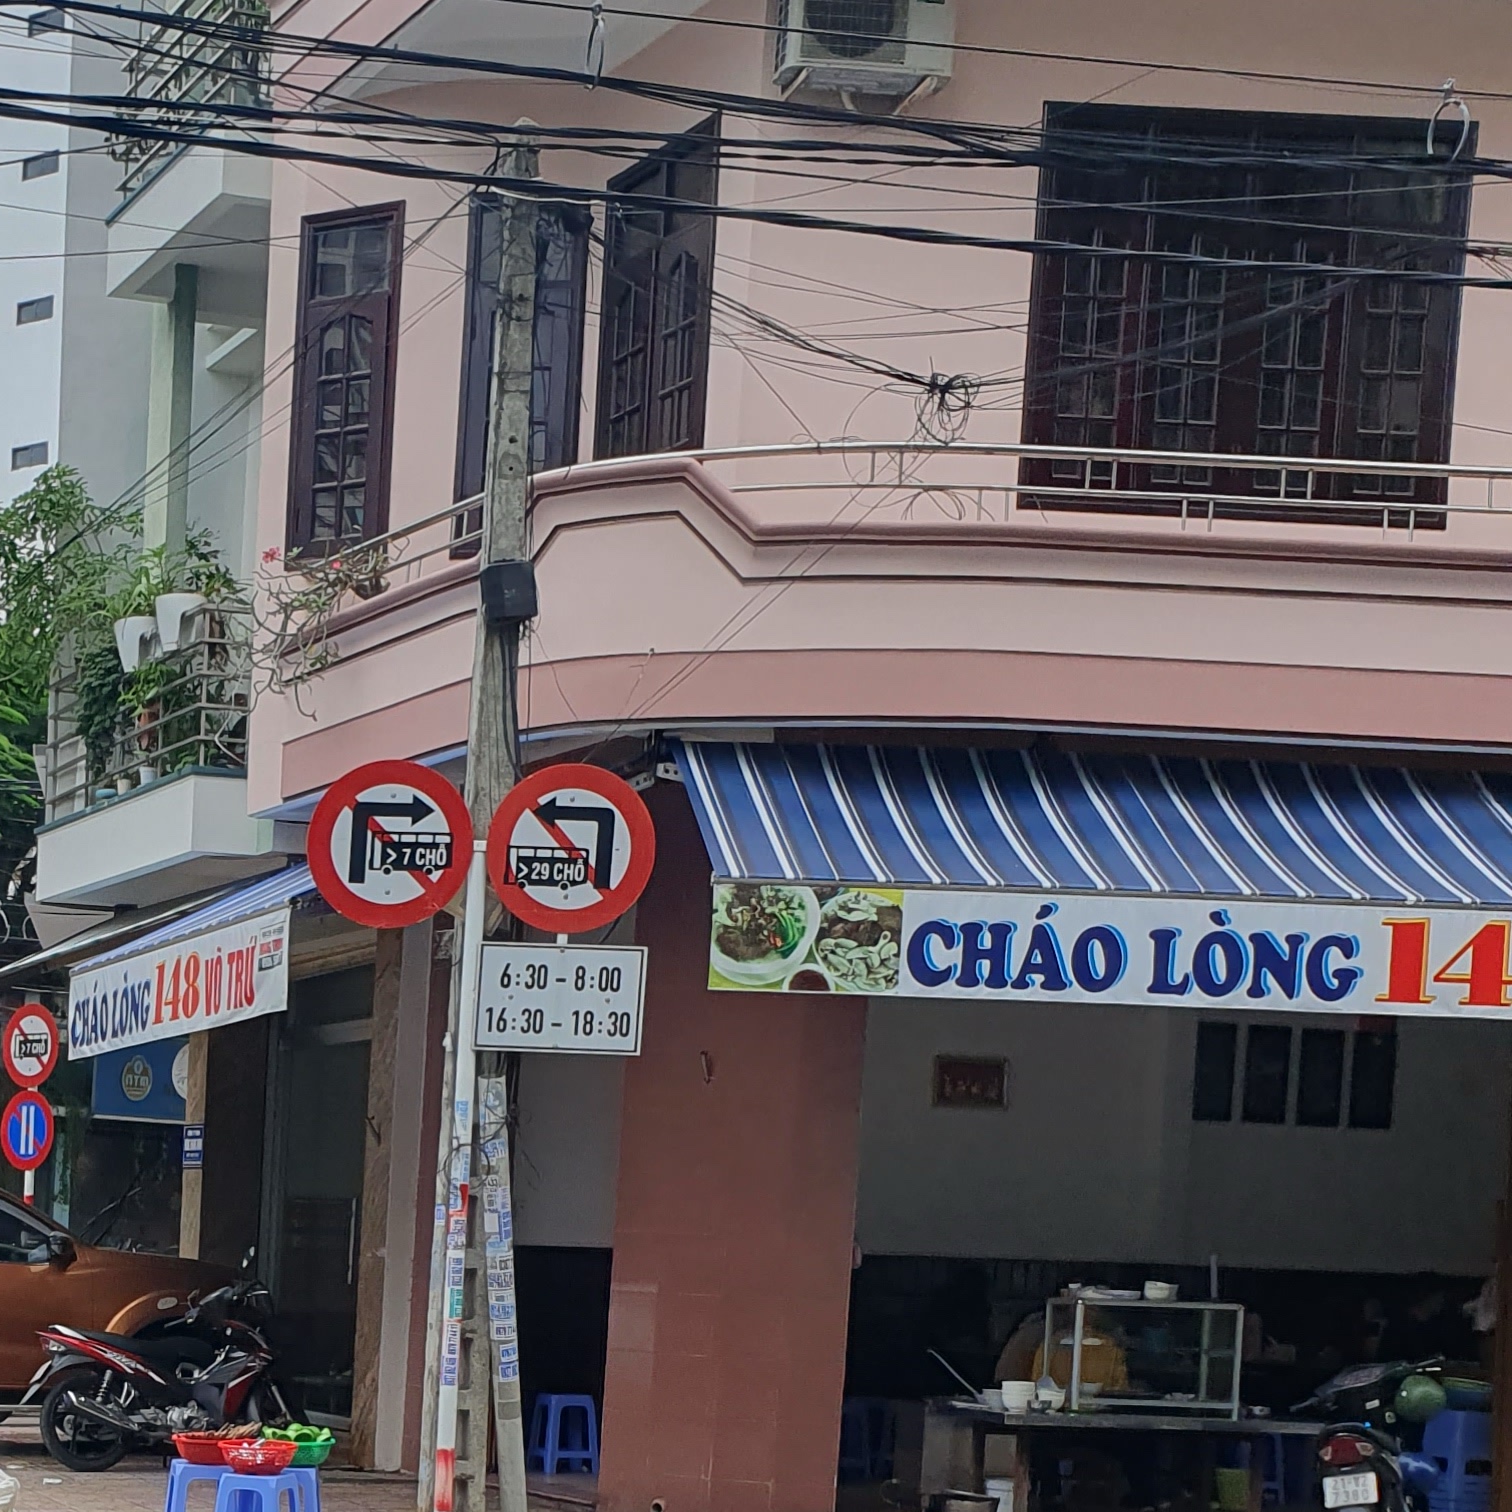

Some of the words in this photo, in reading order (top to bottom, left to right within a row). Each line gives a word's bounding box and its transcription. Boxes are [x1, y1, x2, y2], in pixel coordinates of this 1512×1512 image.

[402, 848, 411, 866] 7
[531, 863, 549, 880] 29
[906, 902, 1128, 993] CHÁO
[1146, 908, 1364, 1002] LÒNG
[500, 963, 548, 990] 6:30
[574, 965, 622, 993] 8:00
[71, 980, 108, 1049] CHÁO
[111, 970, 151, 1039] LÒNG
[152, 951, 200, 1026] 148
[486, 1007, 544, 1034] 16:30
[572, 1010, 631, 1038] 18:30
